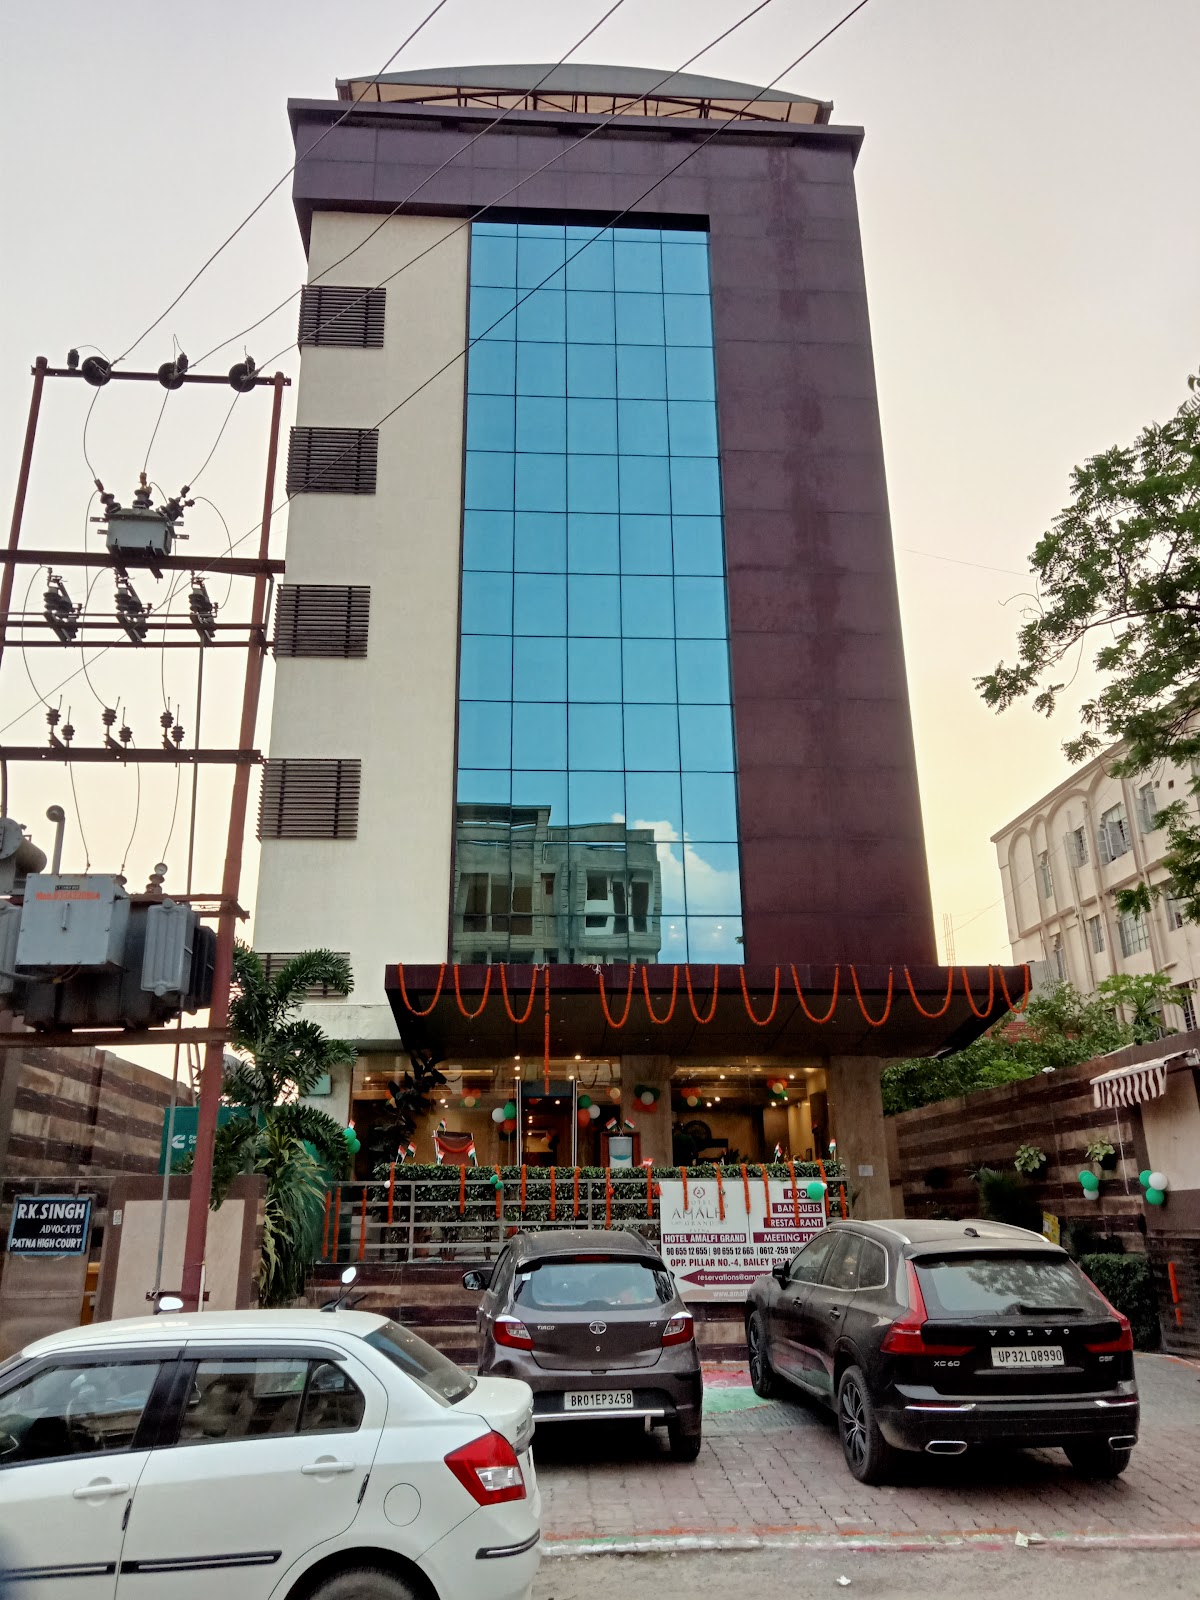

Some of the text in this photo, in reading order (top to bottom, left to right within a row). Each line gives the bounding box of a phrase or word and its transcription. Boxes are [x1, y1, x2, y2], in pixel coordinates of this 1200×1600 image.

[777, 1204, 821, 1213] BANQUETS
[39, 1224, 82, 1234] ADVOCATE
[664, 1234, 746, 1243] HOTEL AMALFI GRAND
[763, 1233, 816, 1242] MEETING HA
[10, 1238, 83, 1249] PATNA HIGH COURT
[670, 1258, 687, 1267] OPP.
[689, 1258, 715, 1267] PILLAR
[743, 1258, 770, 1267] BAILEY
[988, 1328, 1070, 1337] VOLVO
[571, 1393, 632, 1407] BR01EP3458
